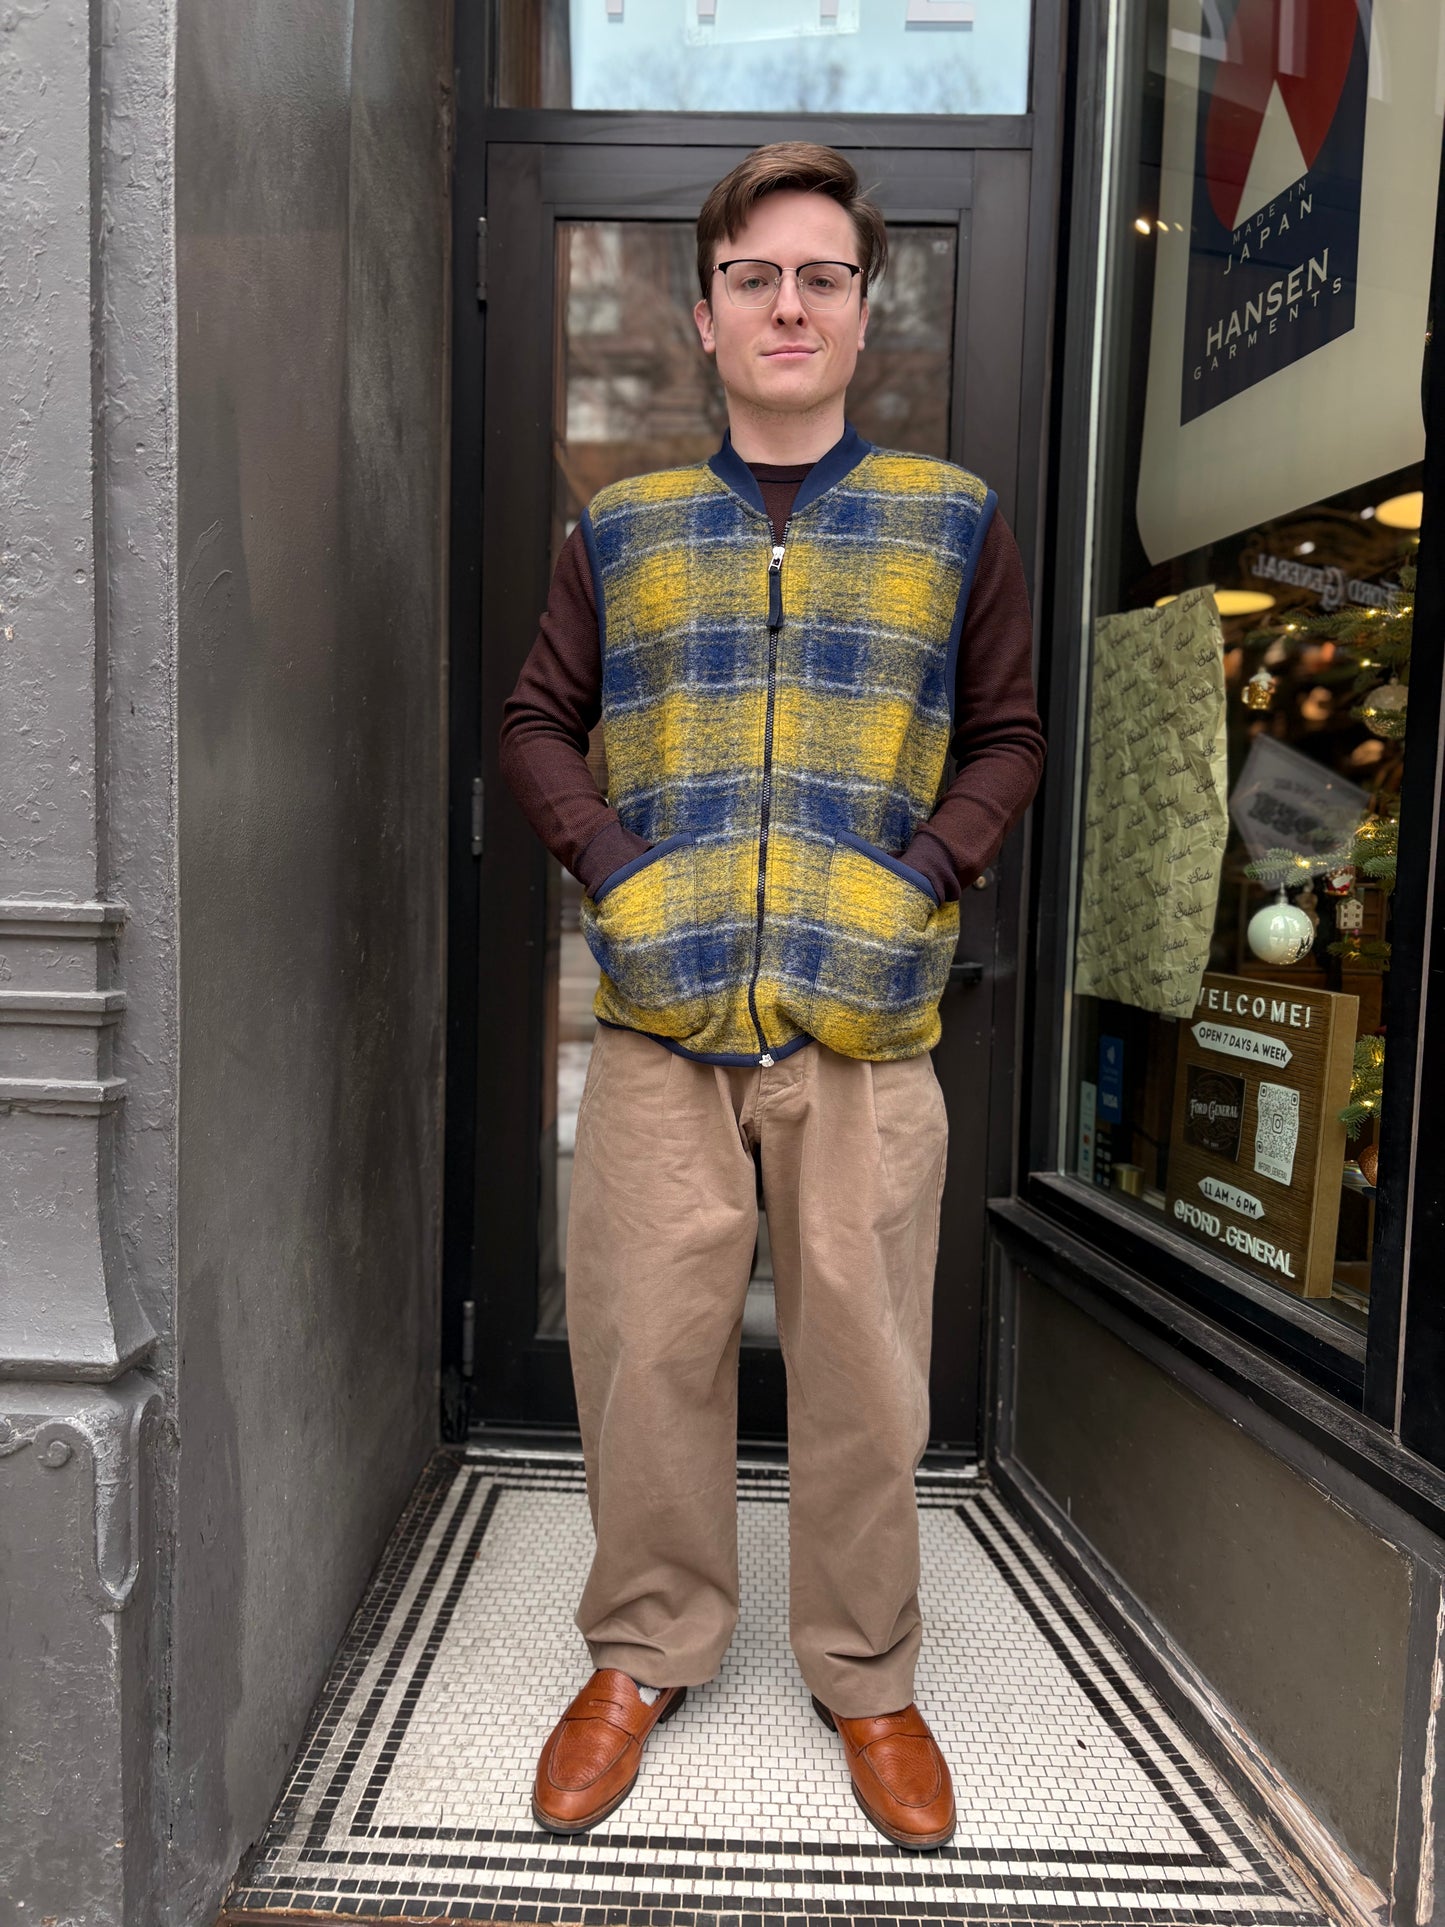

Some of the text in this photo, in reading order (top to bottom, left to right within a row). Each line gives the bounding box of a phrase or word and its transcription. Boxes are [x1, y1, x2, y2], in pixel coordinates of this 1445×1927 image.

[1223, 194, 1313, 275] JAPAN
[1233, 180, 1306, 246] MADE IN
[1193, 278, 1342, 381] GARMENTS
[1206, 247, 1329, 357] HANSEN
[1199, 1027, 1287, 1062] OPEN 7 DAYS A WEEK
[1190, 1098, 1239, 1123] FORD GENERAL
[1204, 1181, 1213, 1195] 11
[1214, 1187, 1229, 1202] AM
[1236, 1195, 1241, 1208] 6
[1243, 1198, 1257, 1215] PM
[1174, 1199, 1295, 1279] @FORD_GENERAL
